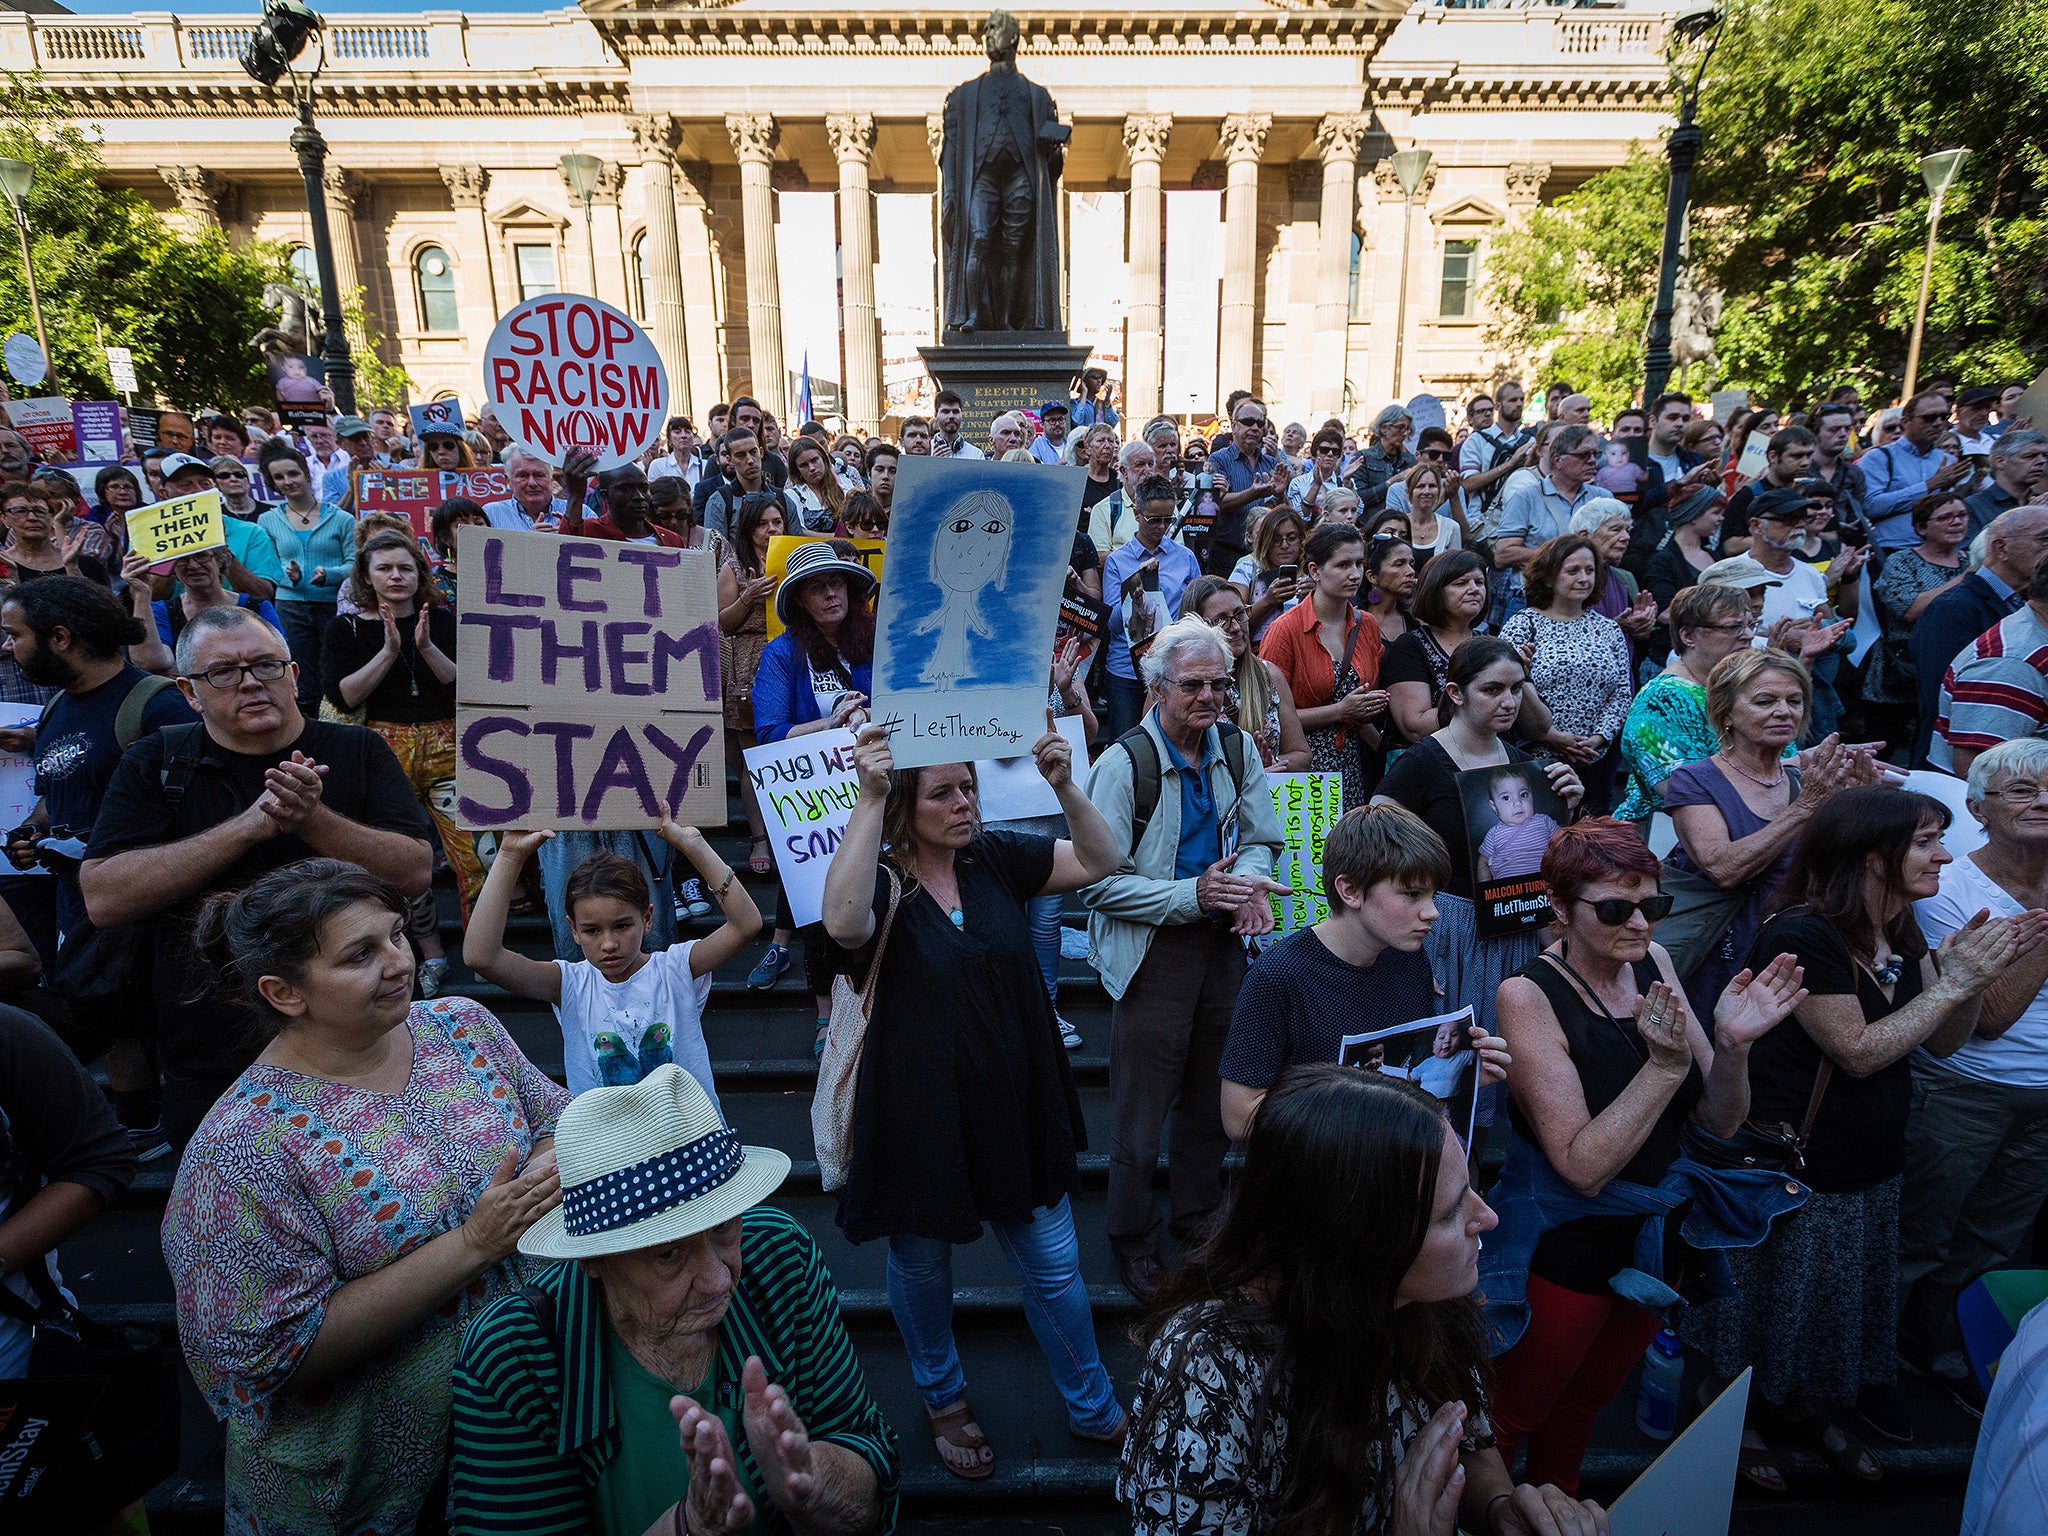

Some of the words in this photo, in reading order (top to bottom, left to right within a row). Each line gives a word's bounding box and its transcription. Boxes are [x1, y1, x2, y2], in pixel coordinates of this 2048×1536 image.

[509, 301, 635, 360] STOP
[492, 357, 661, 410] RACISM
[974, 386, 1038, 397] ERECTED
[974, 399, 1026, 407] GRATEFUL
[359, 472, 430, 501] FREE
[438, 470, 511, 501] PASS
[150, 513, 209, 537] THEM
[159, 500, 197, 519] LET
[156, 529, 207, 553] STAY
[483, 538, 682, 617] LET
[1060, 597, 1098, 621] #LetThemSta
[460, 612, 722, 701] THEM
[457, 716, 715, 826] STAY
[748, 754, 815, 792] BACK
[1285, 779, 1304, 812] not
[1484, 883, 1523, 901] MALCOLM
[1524, 880, 1546, 893] TURN
